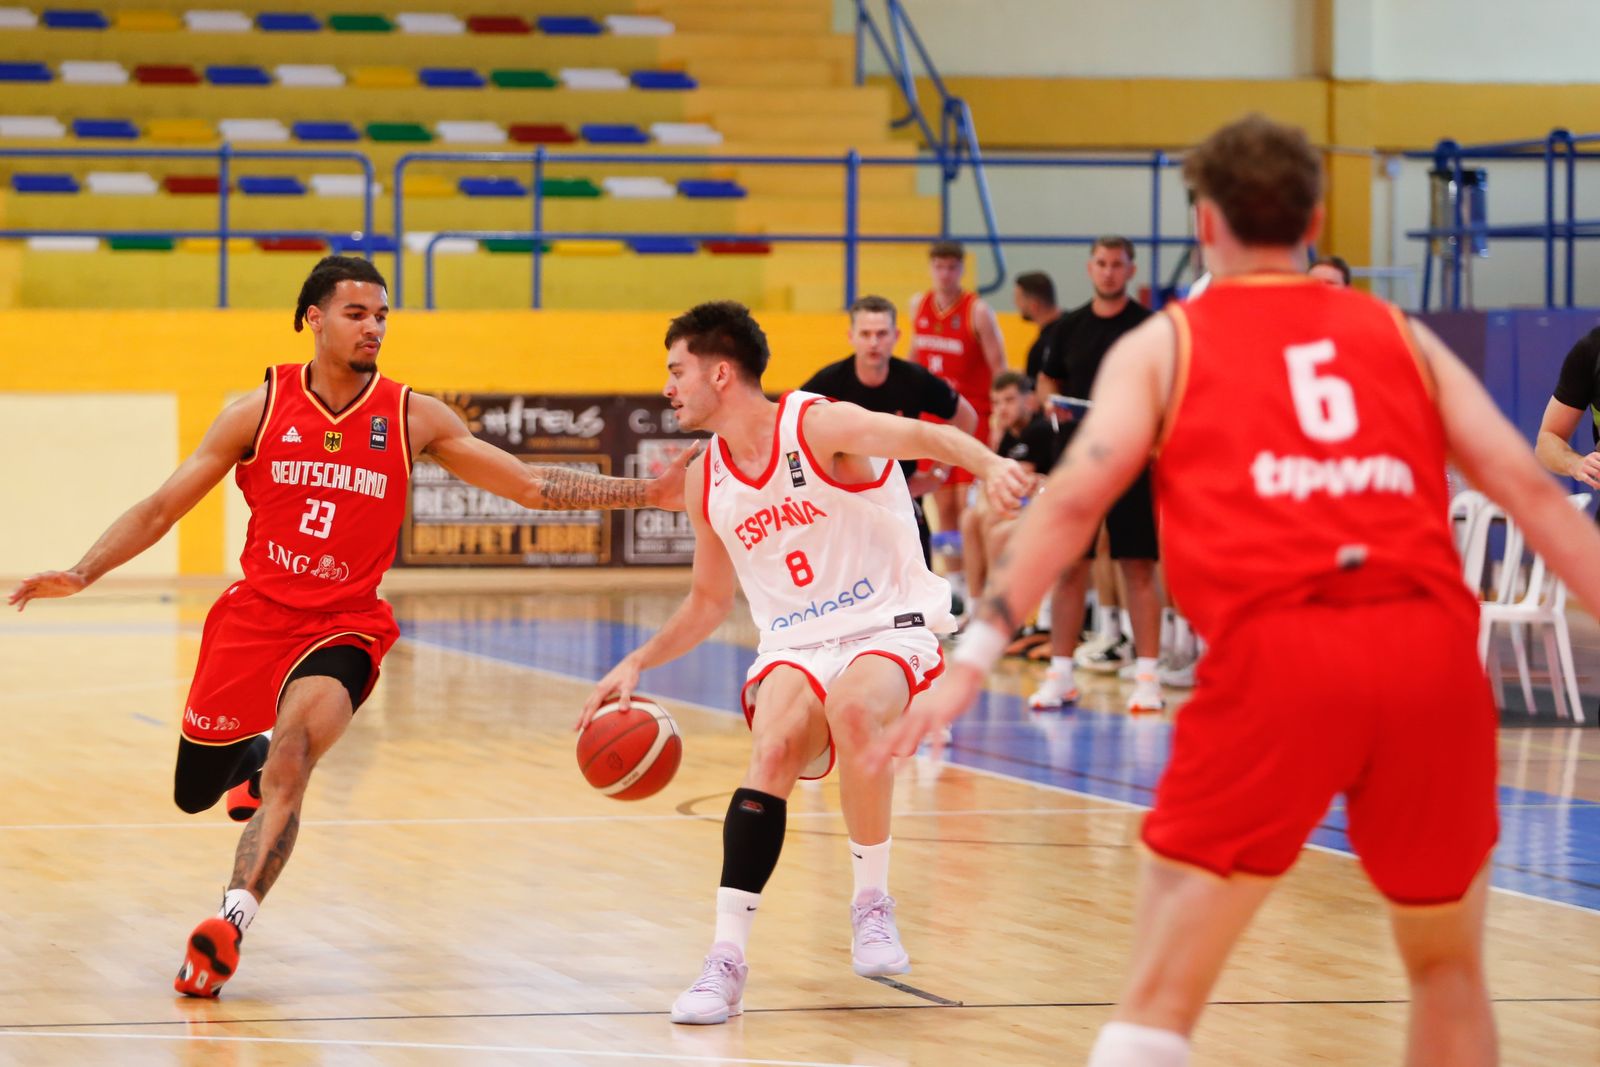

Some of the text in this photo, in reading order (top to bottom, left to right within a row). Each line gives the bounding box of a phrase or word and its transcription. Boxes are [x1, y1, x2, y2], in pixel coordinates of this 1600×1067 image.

[1283, 338, 1359, 444] 6
[282, 435, 302, 443] PEAK
[271, 461, 388, 499] DEUTSCHLAND
[299, 498, 336, 540] 23
[735, 497, 828, 551] ESPAÑA
[267, 540, 311, 575] ING
[785, 550, 814, 587] 8
[771, 577, 875, 631] endesa
[184, 706, 211, 731] ING
